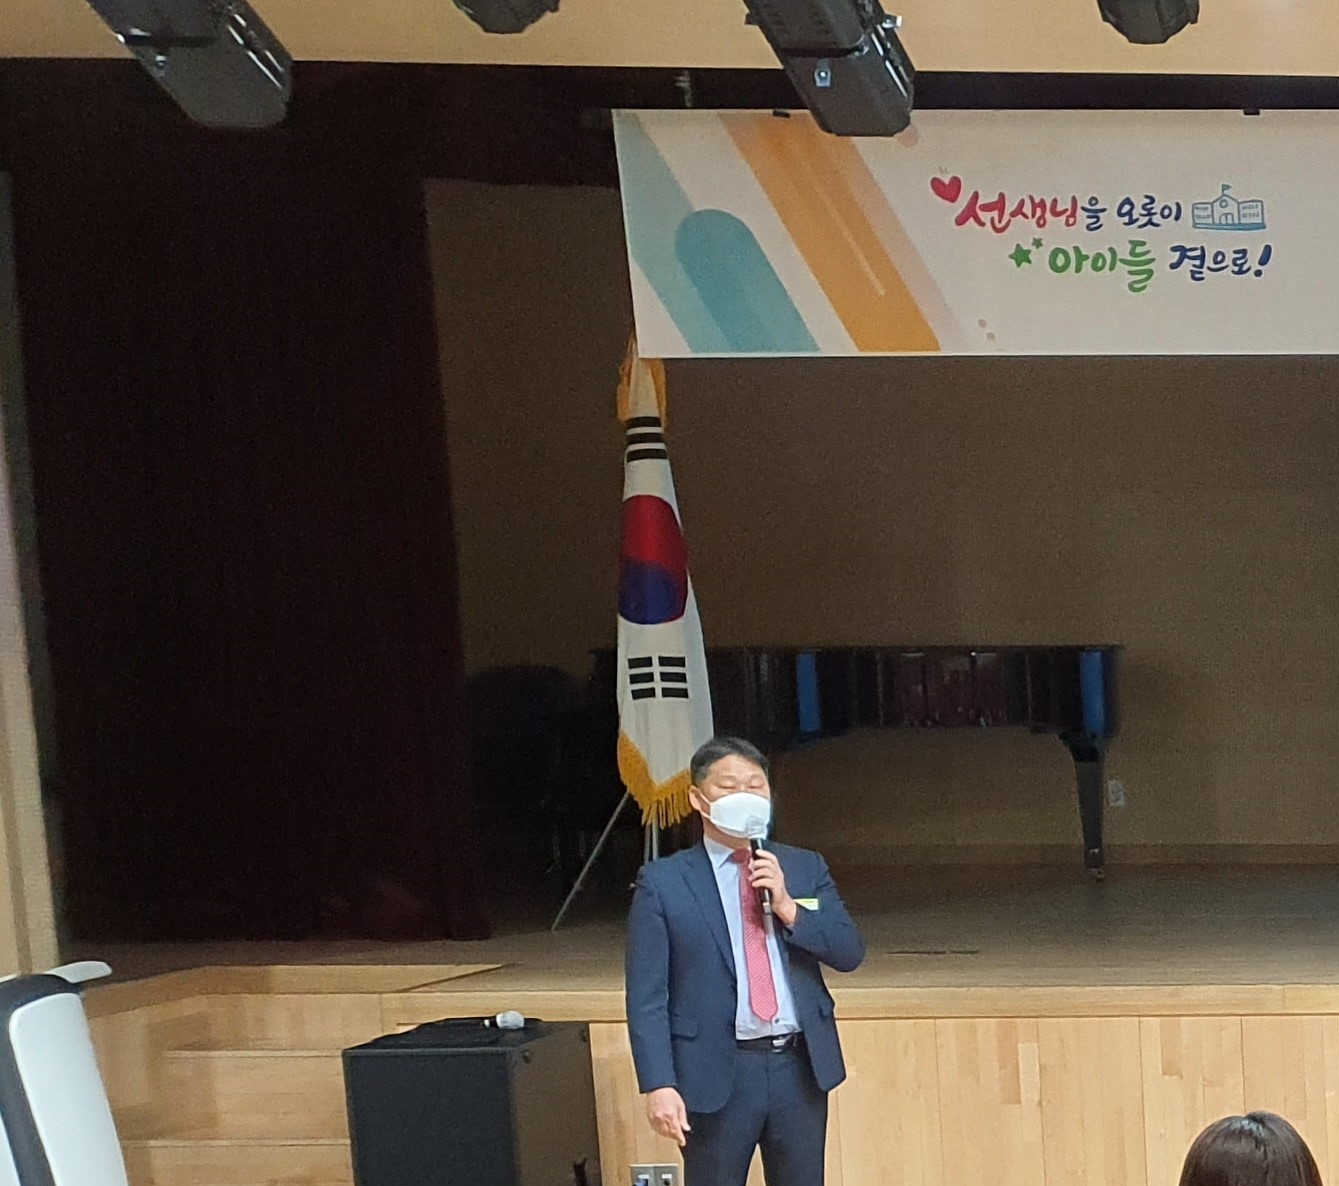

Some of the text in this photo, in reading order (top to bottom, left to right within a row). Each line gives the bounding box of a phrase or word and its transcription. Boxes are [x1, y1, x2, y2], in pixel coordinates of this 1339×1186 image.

[954, 189, 1184, 233] 선생님을 오롯이
[1048, 240, 1273, 293] 아이들 곁으로!
